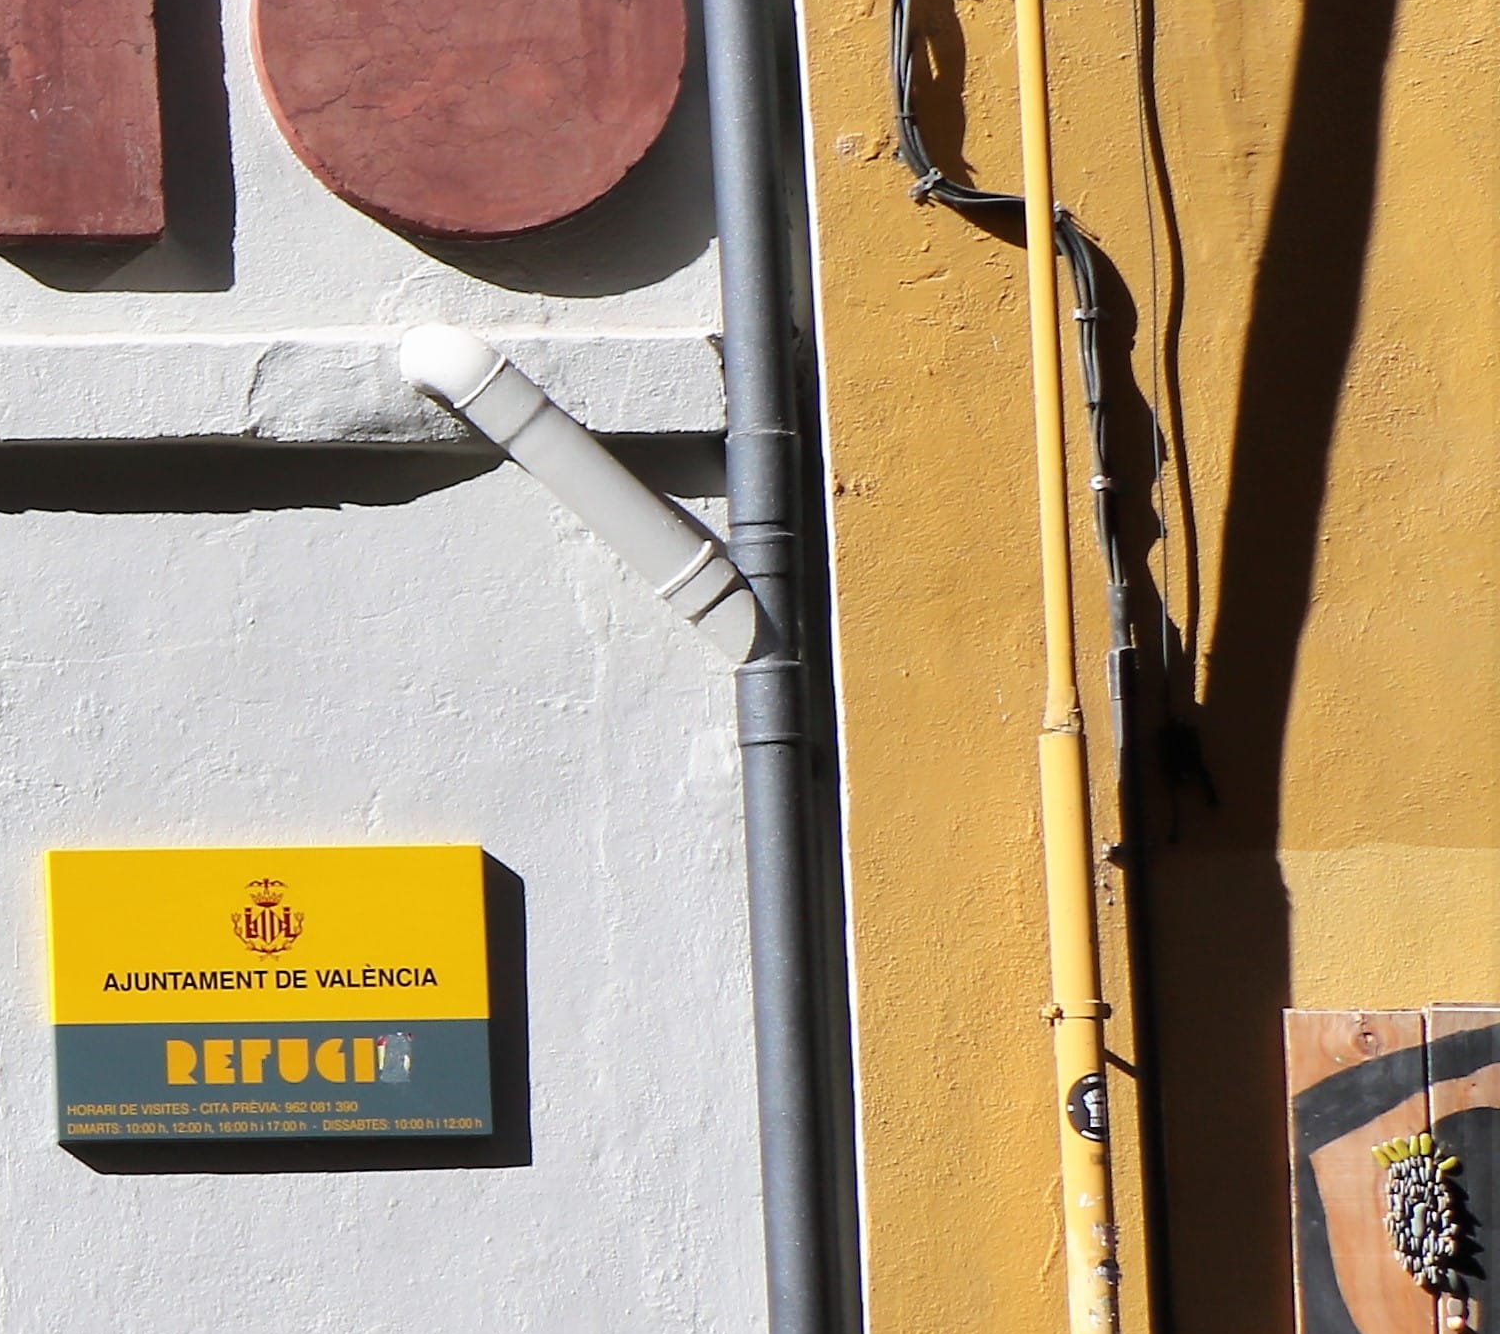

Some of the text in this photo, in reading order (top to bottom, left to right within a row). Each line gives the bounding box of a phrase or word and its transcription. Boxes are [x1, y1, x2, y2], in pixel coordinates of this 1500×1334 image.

[103, 964, 438, 992] AJUNTAMENT DE VALÈNCIA
[166, 1037, 411, 1085] REFUGI
[67, 1104, 116, 1116] HORARI
[119, 1104, 138, 1115] DE
[141, 1103, 189, 1115] VISITES
[200, 1102, 229, 1114] CITA
[285, 1101, 308, 1114] 962
[67, 1122, 122, 1135] DIMARTS:
[323, 1119, 390, 1132] DISSABTES:
